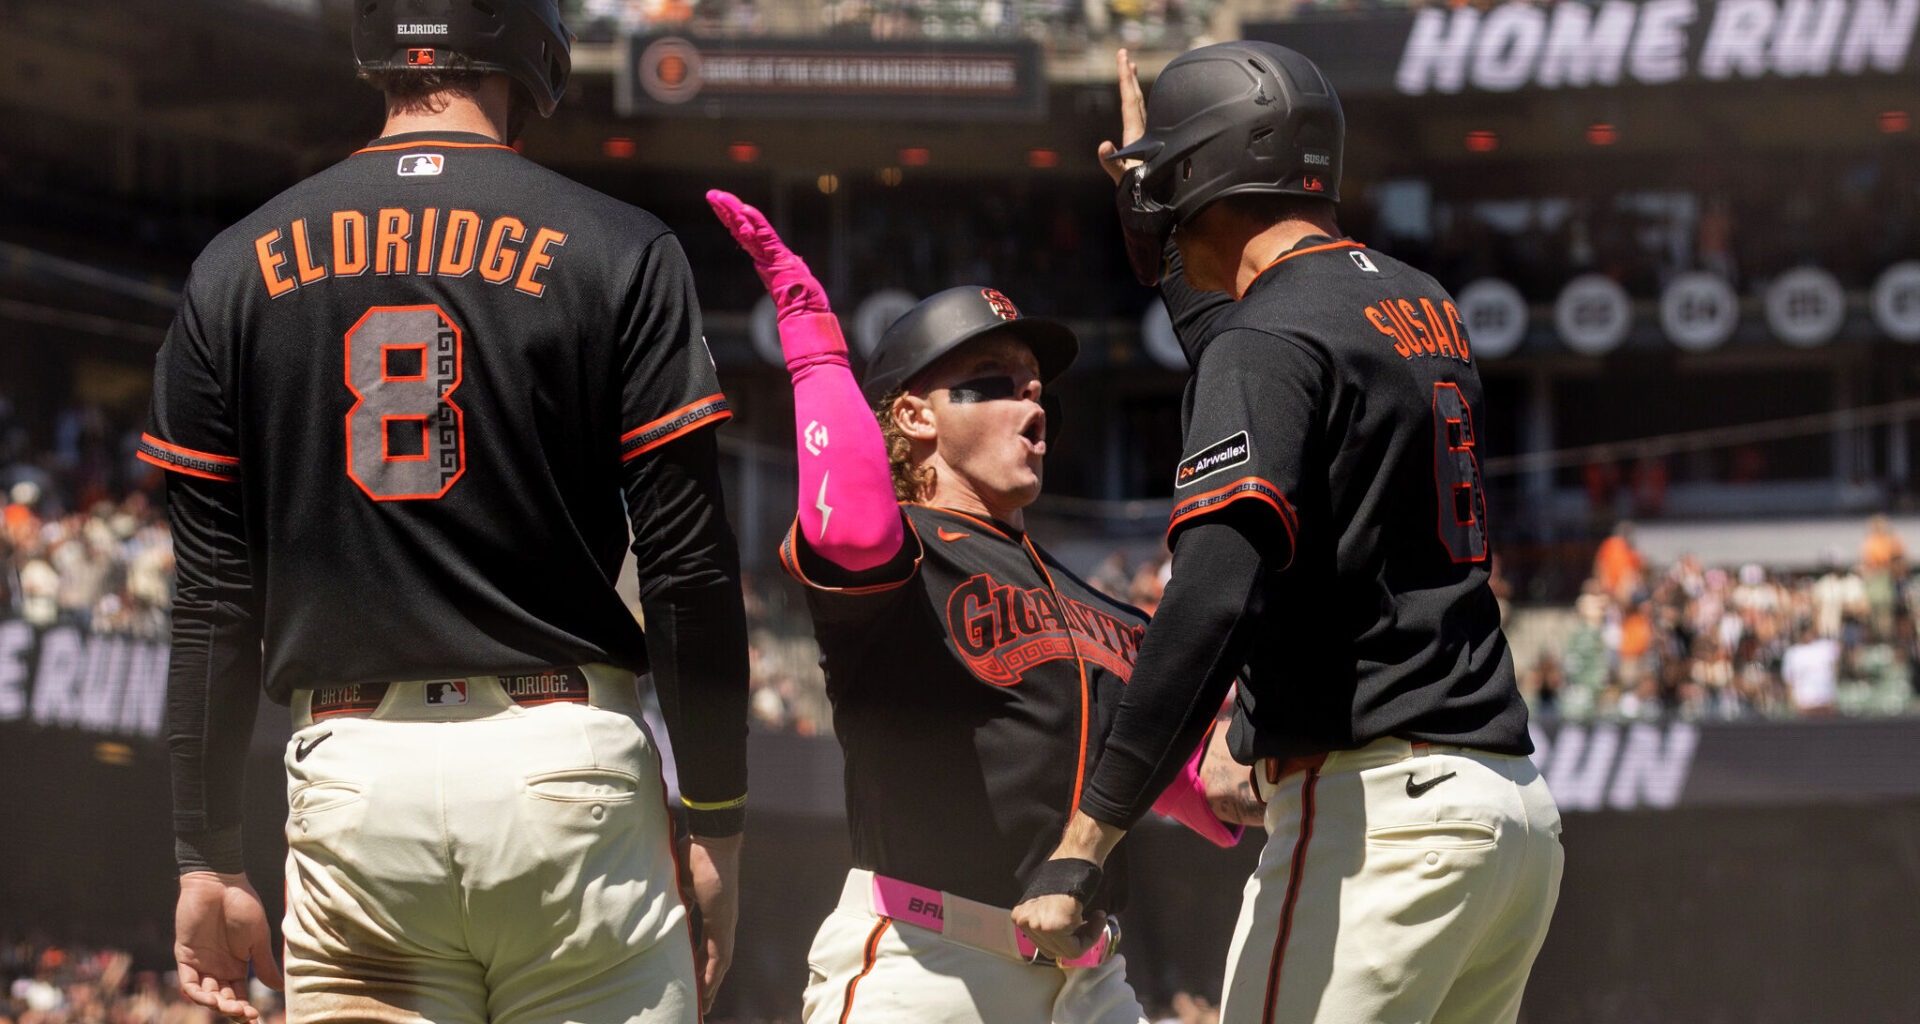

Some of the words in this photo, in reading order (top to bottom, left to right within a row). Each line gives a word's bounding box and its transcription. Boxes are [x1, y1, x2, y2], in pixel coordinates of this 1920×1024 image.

[397, 24, 448, 35] ELDRIDGE
[1397, 4, 1695, 94] HOME
[1699, 0, 1920, 80] RUN
[1303, 153, 1330, 166] SUSAC
[255, 207, 568, 300] ELDRIDGE
[1364, 297, 1471, 364] SUSAC
[344, 304, 466, 501] 8
[1195, 444, 1246, 473] Airwallex
[33, 628, 170, 735] RUN
